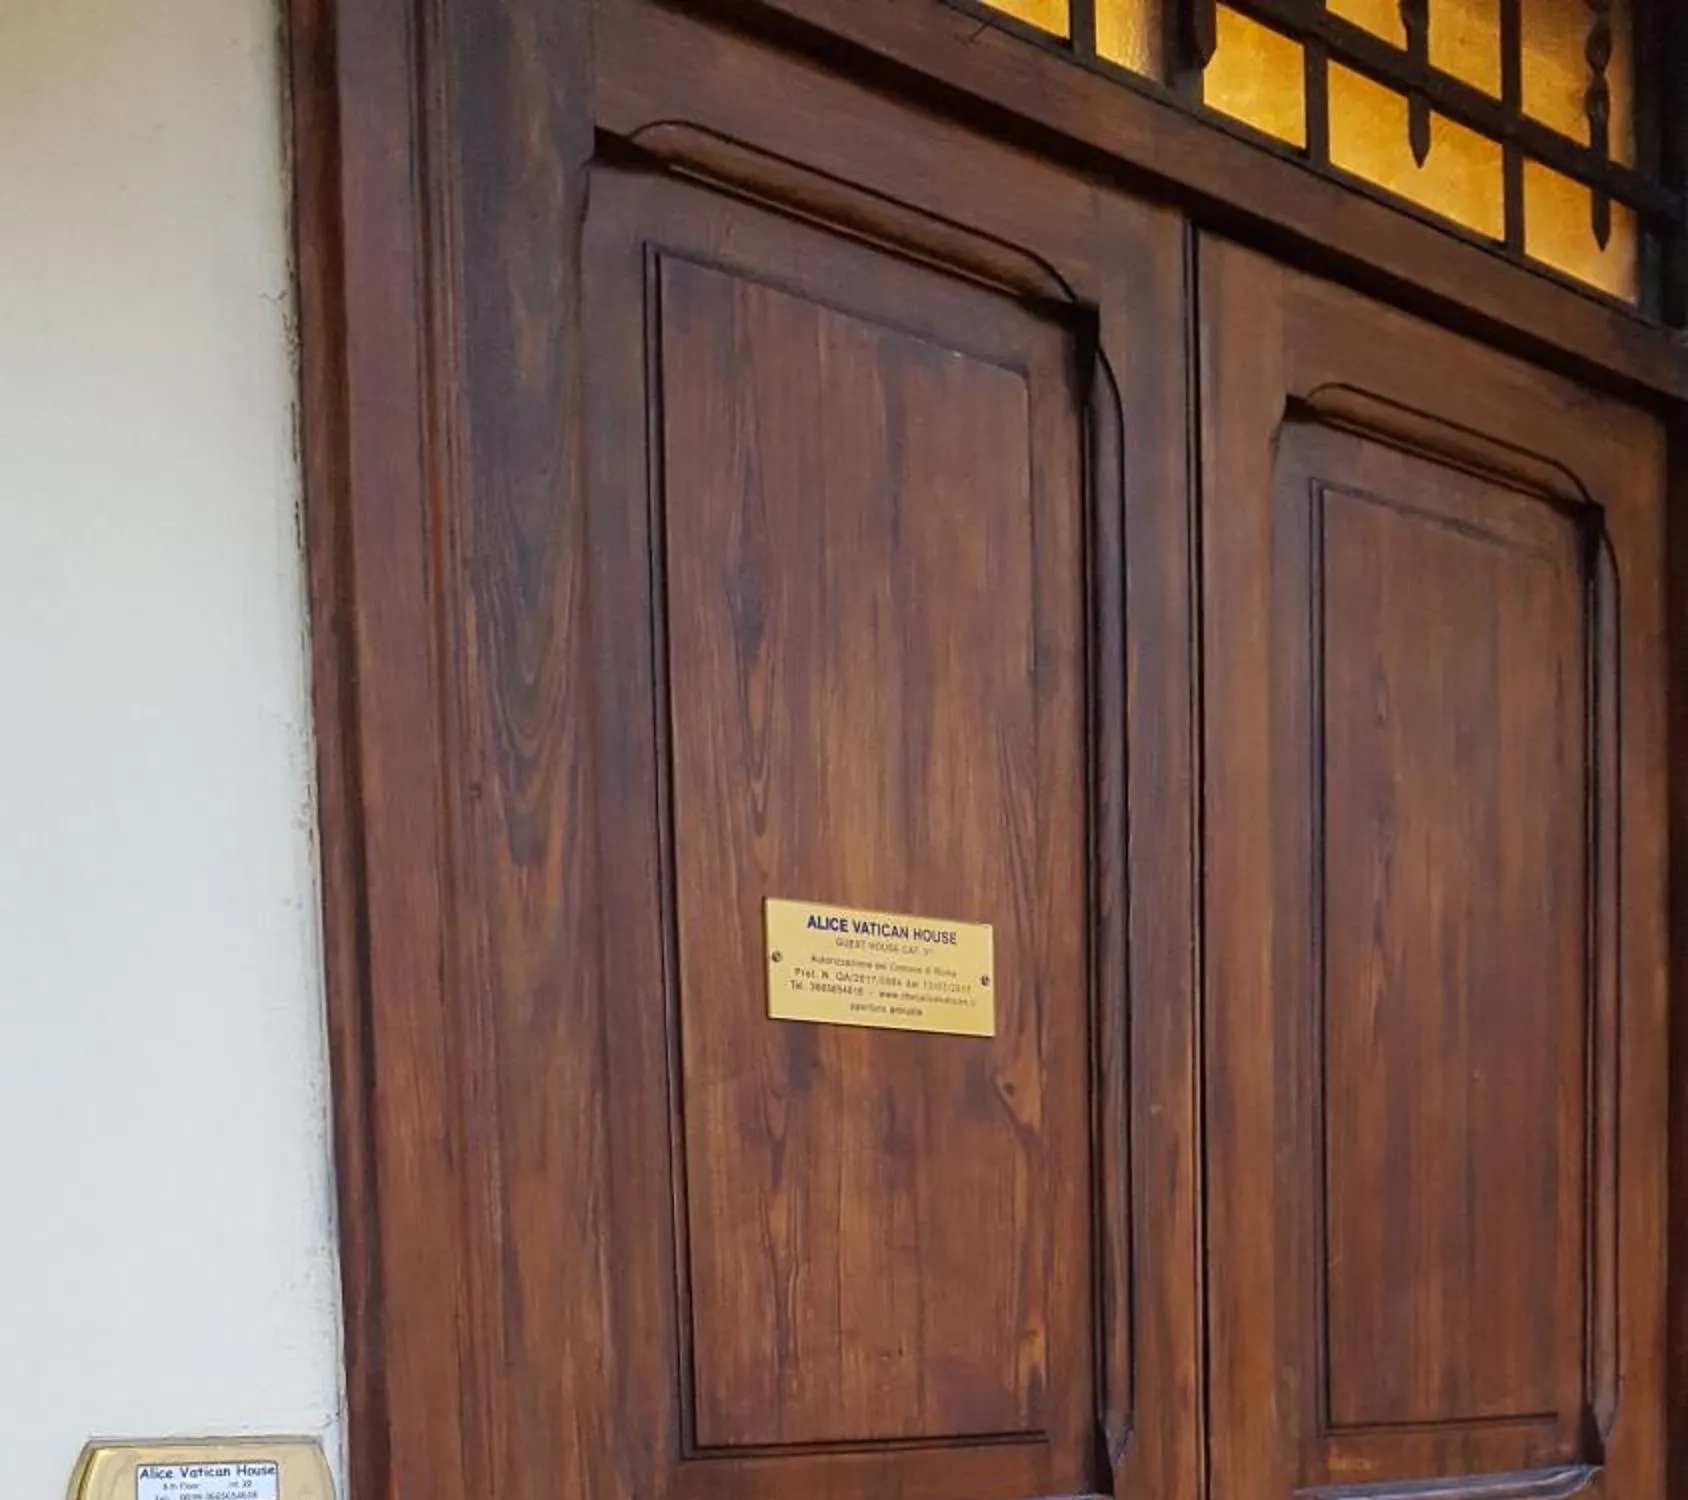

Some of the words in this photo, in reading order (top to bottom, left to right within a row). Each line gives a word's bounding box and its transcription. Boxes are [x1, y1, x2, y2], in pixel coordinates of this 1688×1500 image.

[806, 914, 849, 933] ALICE
[852, 920, 910, 940] VATICAN
[912, 927, 957, 945] HOUSE
[835, 937, 866, 949] GUEST
[140, 1467, 174, 1480] Alice
[180, 1465, 231, 1479] Vatican
[236, 1463, 276, 1477] House
